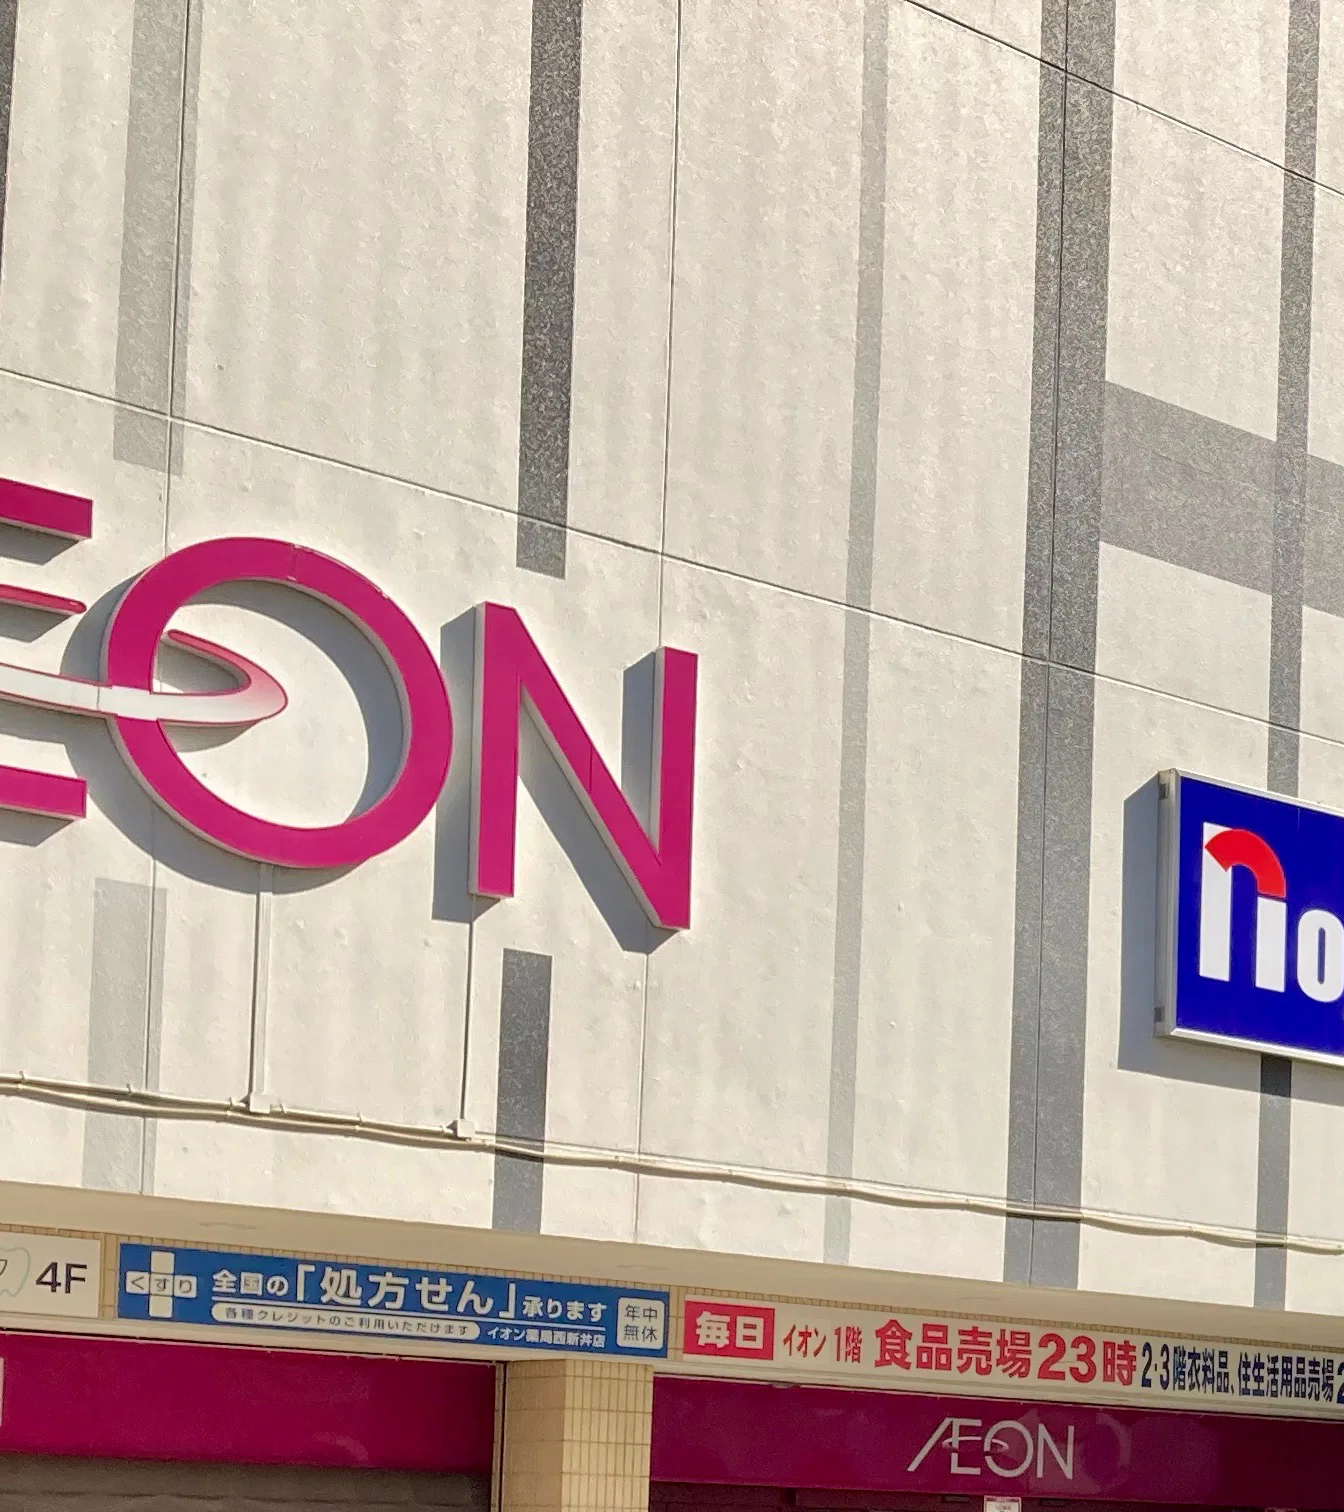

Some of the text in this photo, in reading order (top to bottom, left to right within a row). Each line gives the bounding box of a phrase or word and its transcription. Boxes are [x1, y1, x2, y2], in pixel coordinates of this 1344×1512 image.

[35, 1261, 88, 1294] 4F
[130, 1276, 193, 1294] くすり
[624, 1303, 658, 1323] 年中
[623, 1324, 658, 1343] 無休
[696, 1311, 765, 1350] 毎日
